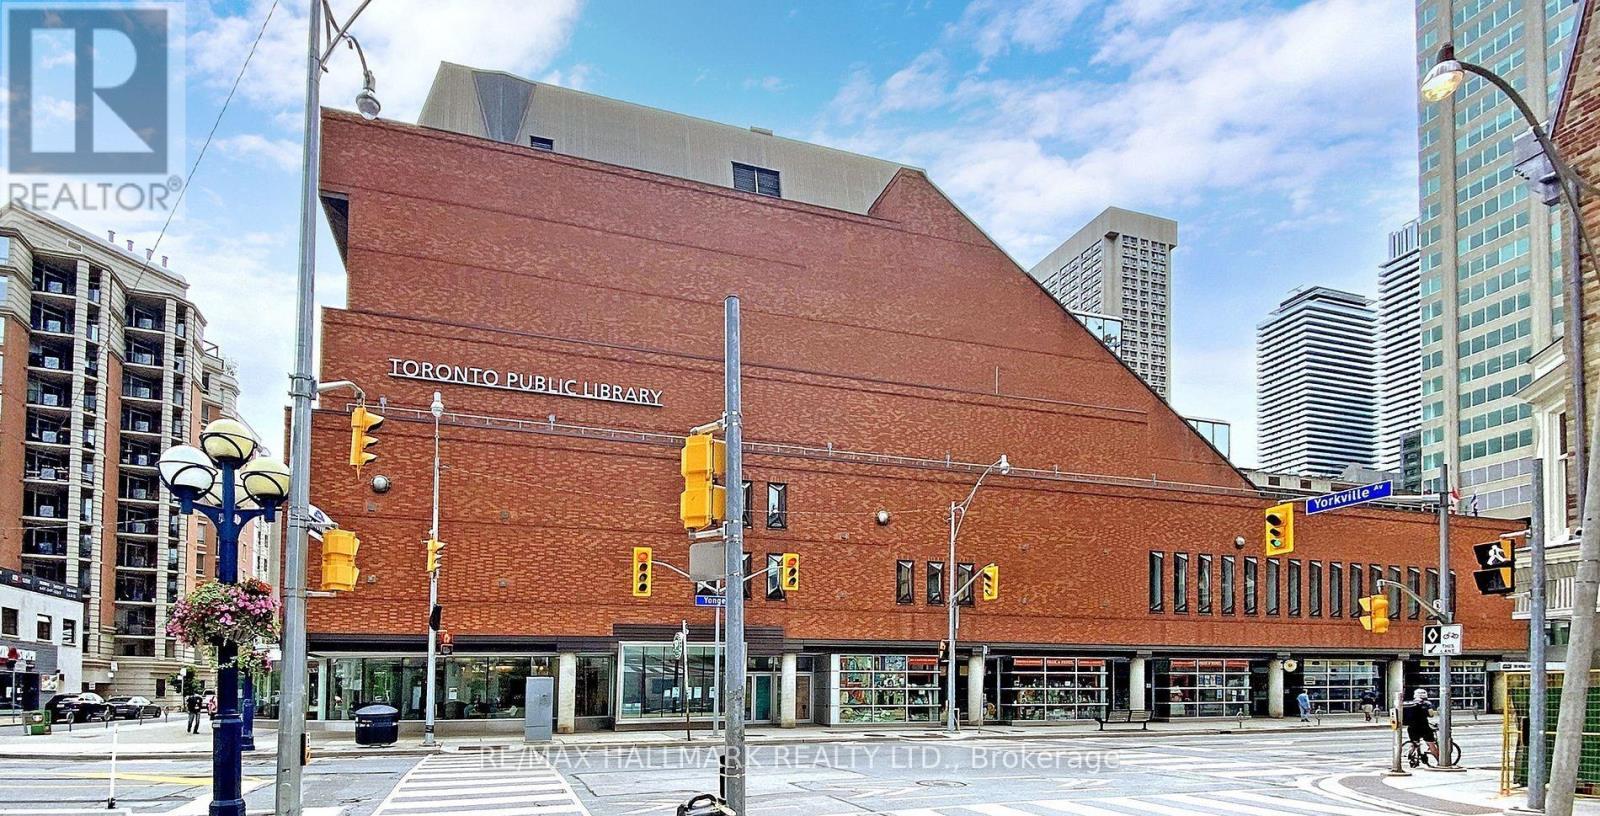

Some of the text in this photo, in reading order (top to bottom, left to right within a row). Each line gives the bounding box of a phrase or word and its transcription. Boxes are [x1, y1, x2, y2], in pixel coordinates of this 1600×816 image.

[388, 358, 663, 405] TORONTO PUBLIC LIBRARY
[1314, 489, 1370, 509] Yorkville
[704, 596, 726, 605] Yonge
